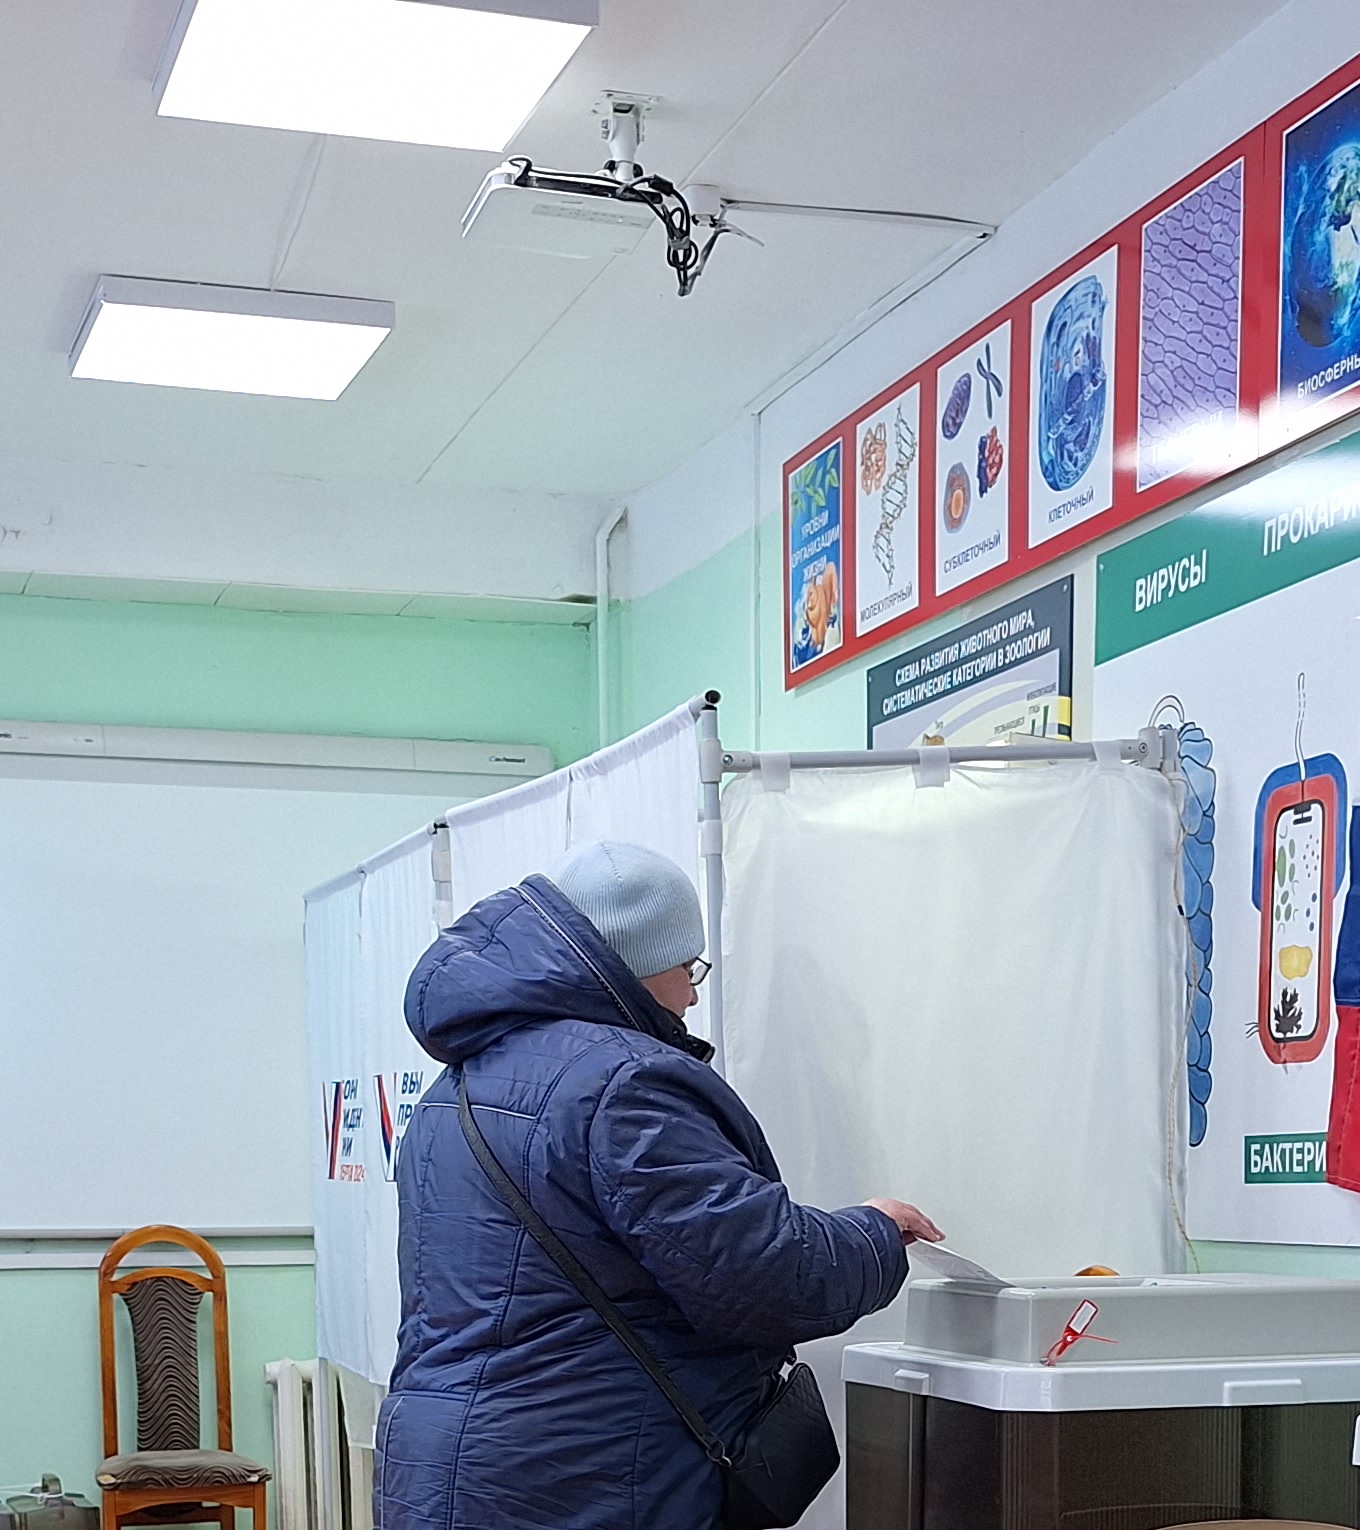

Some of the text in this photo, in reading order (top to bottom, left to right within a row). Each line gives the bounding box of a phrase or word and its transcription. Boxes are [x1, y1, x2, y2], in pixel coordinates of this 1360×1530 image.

[1047, 486, 1095, 524] КЛЕТОЧНЫЙ
[792, 524, 840, 568] ОРГАНИЗАЦИИ
[943, 529, 1002, 574] СУБКЛЕТОЧНЫЙ
[859, 581, 914, 623] МОЛЕКУЛЯРНЫЙ
[1134, 549, 1208, 613] ВИРУСЫ
[894, 608, 1036, 688] СХЕМА РАЗВИТИЯ ЖИВОТНОГО МИРА,
[882, 626, 1052, 716] СИСТЕМАТИЧЕСКИЕ КАТЕГОРИИ В ЗООЛОГИИ
[1250, 1141, 1328, 1174] БАКТЕРИ
